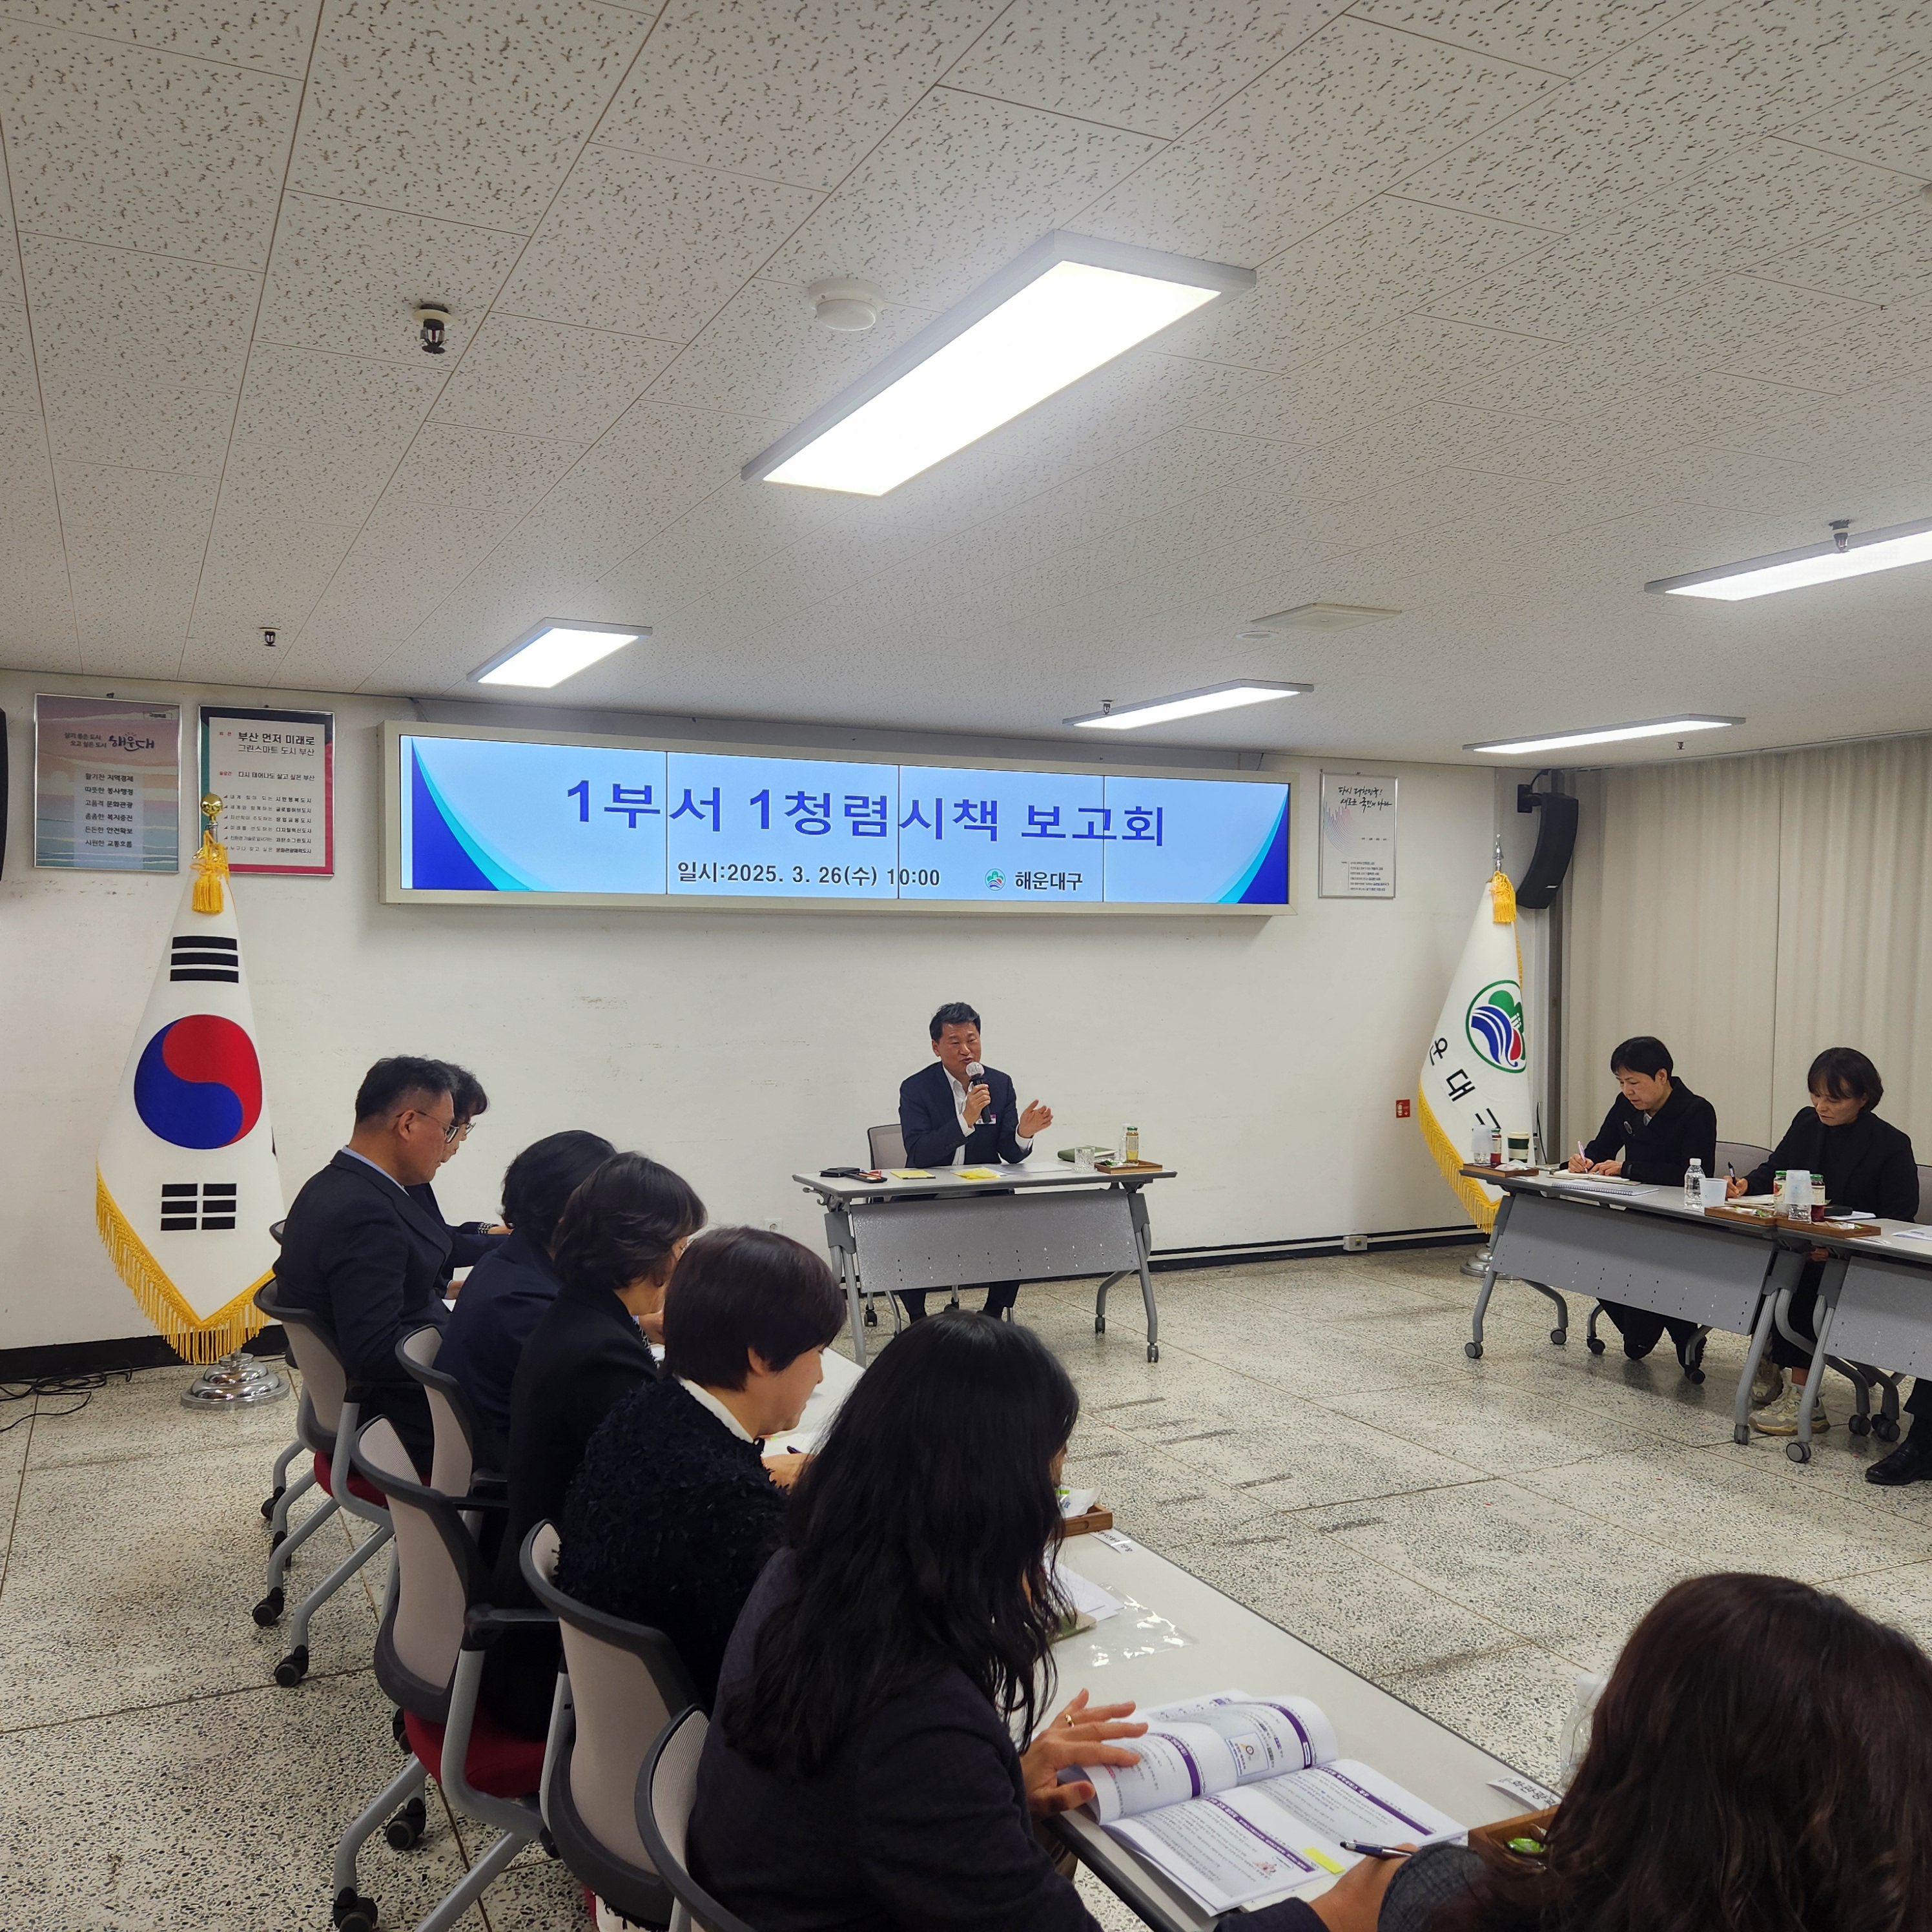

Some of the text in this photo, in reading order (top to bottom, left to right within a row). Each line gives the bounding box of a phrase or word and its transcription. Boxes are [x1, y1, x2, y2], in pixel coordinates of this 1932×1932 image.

[108, 735, 155, 752] 해운대
[238, 732, 315, 746] 부산 먼저 미래로
[238, 744, 314, 756] 그린스마트 도시 부산
[85, 773, 134, 783] 활기찬 지역경제
[107, 787, 134, 796] 봉사행정
[1338, 785, 1383, 798] 다시 대한민국!
[107, 801, 133, 809] 문화관광
[1359, 796, 1376, 814] 국민의
[1377, 798, 1393, 812] 나라
[107, 814, 133, 822] 복지증진
[567, 779, 1163, 847] 1부서 1청렴시책 보고회
[678, 861, 940, 887] 일시:2025. 3. 26(수) 10:00
[1015, 870, 1084, 891] 해운대구
